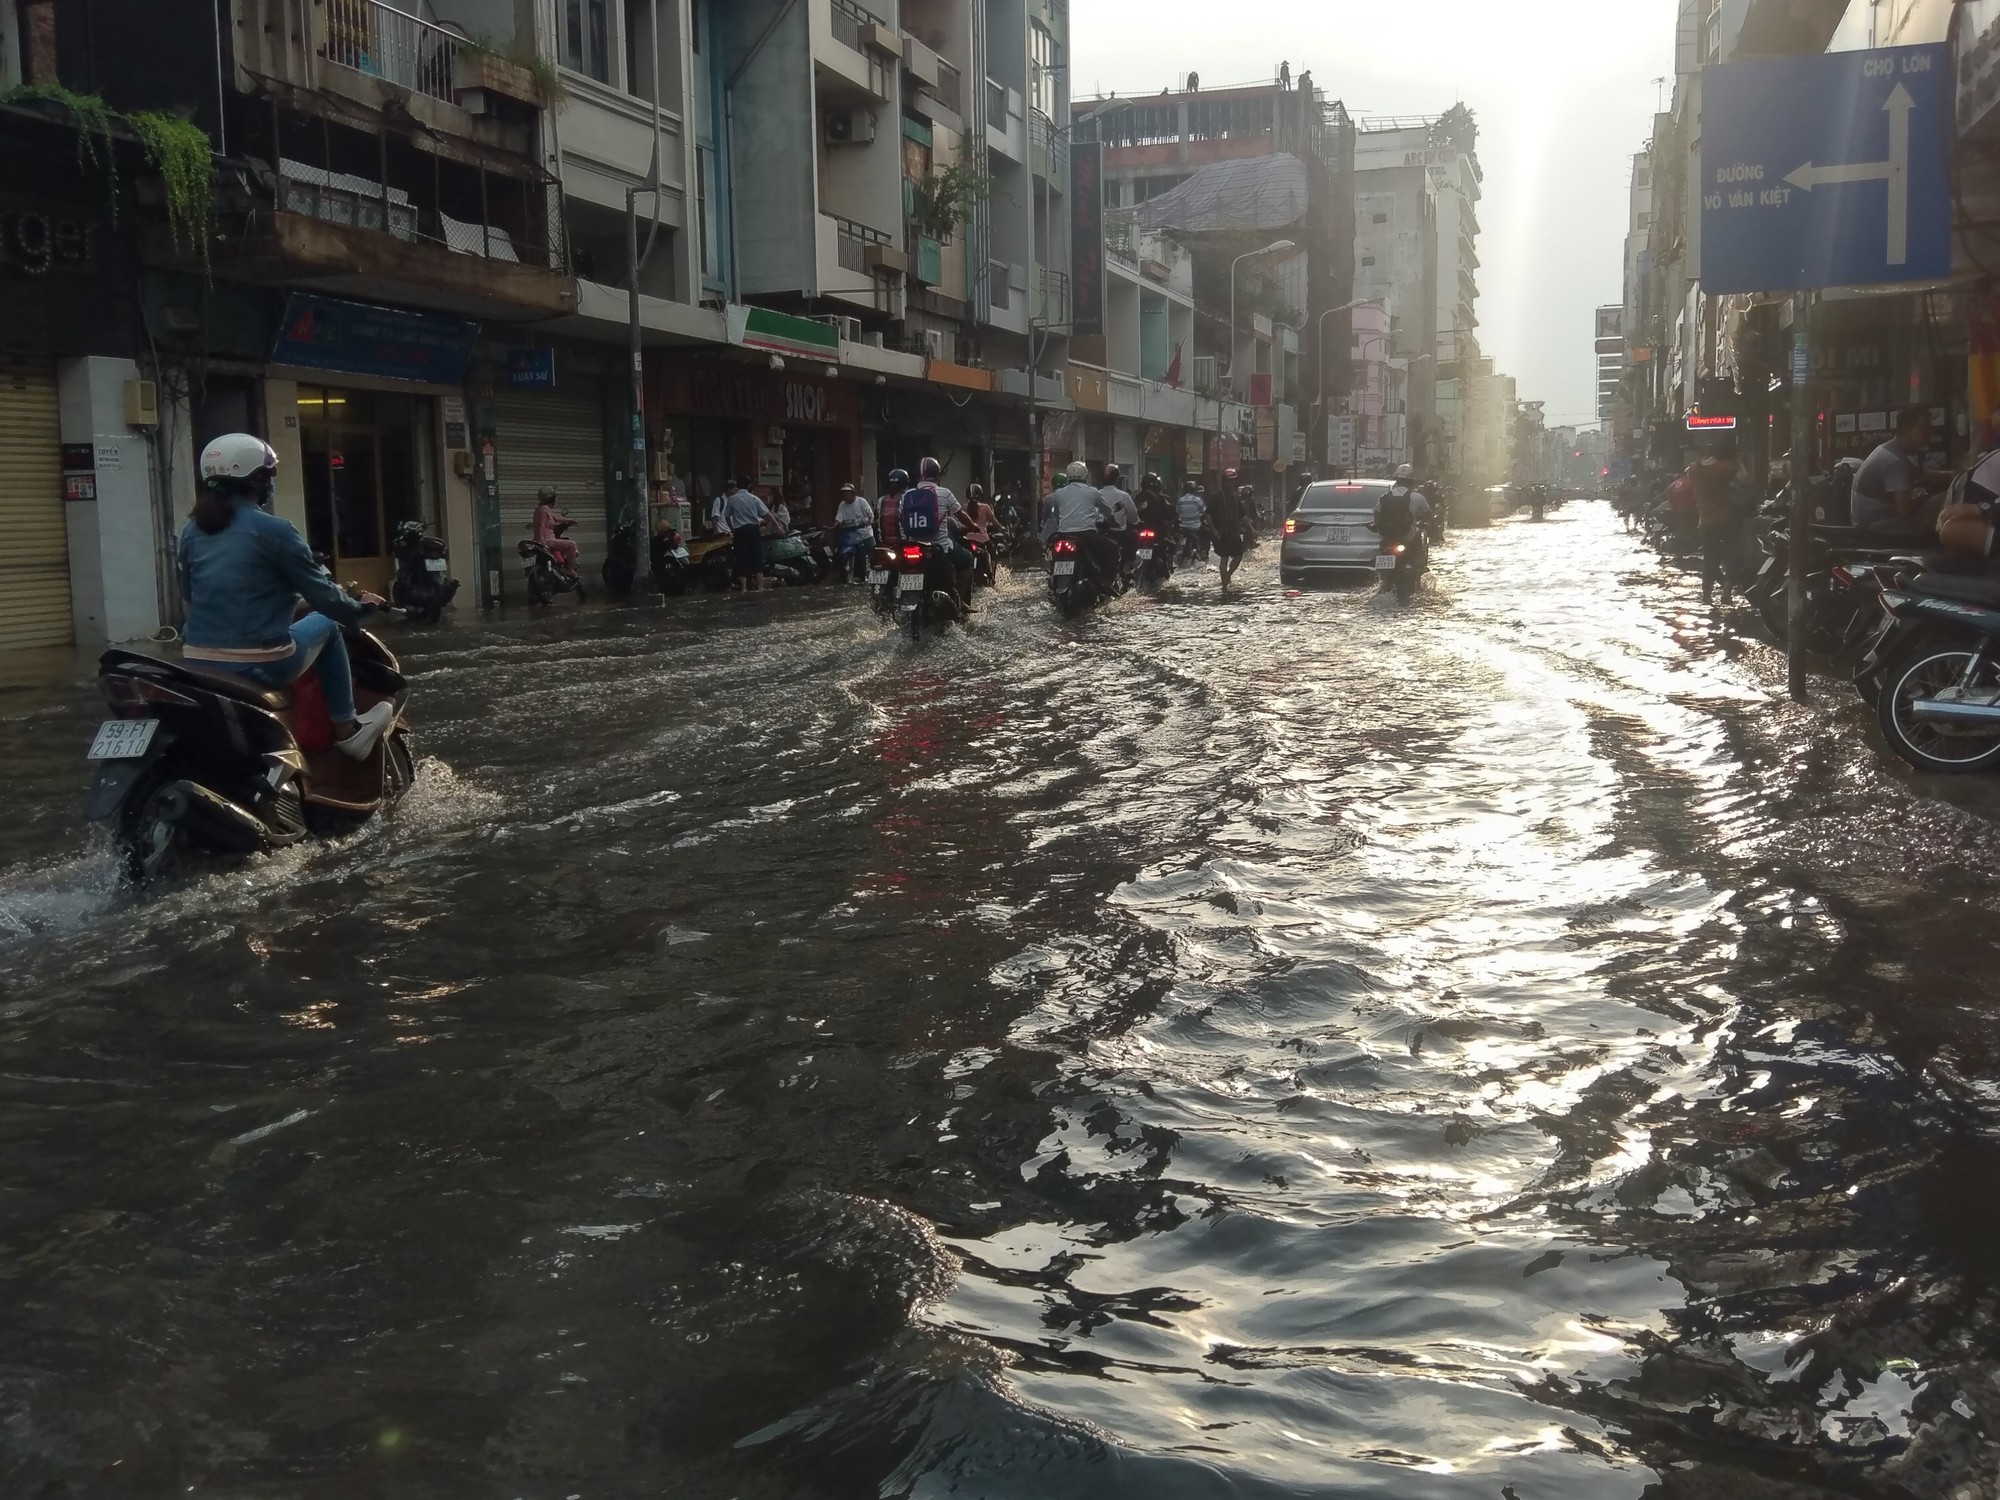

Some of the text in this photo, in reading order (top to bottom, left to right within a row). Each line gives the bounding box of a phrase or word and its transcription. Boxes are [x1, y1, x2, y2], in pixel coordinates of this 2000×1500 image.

[1863, 54, 1931, 81] CHỢ LỚN
[1716, 162, 1764, 184] ĐƯỜNG
[1760, 186, 1792, 209] KIỆT
[909, 511, 928, 529] ila
[105, 722, 148, 739] 59-F1
[93, 739, 146, 756] 216.10
